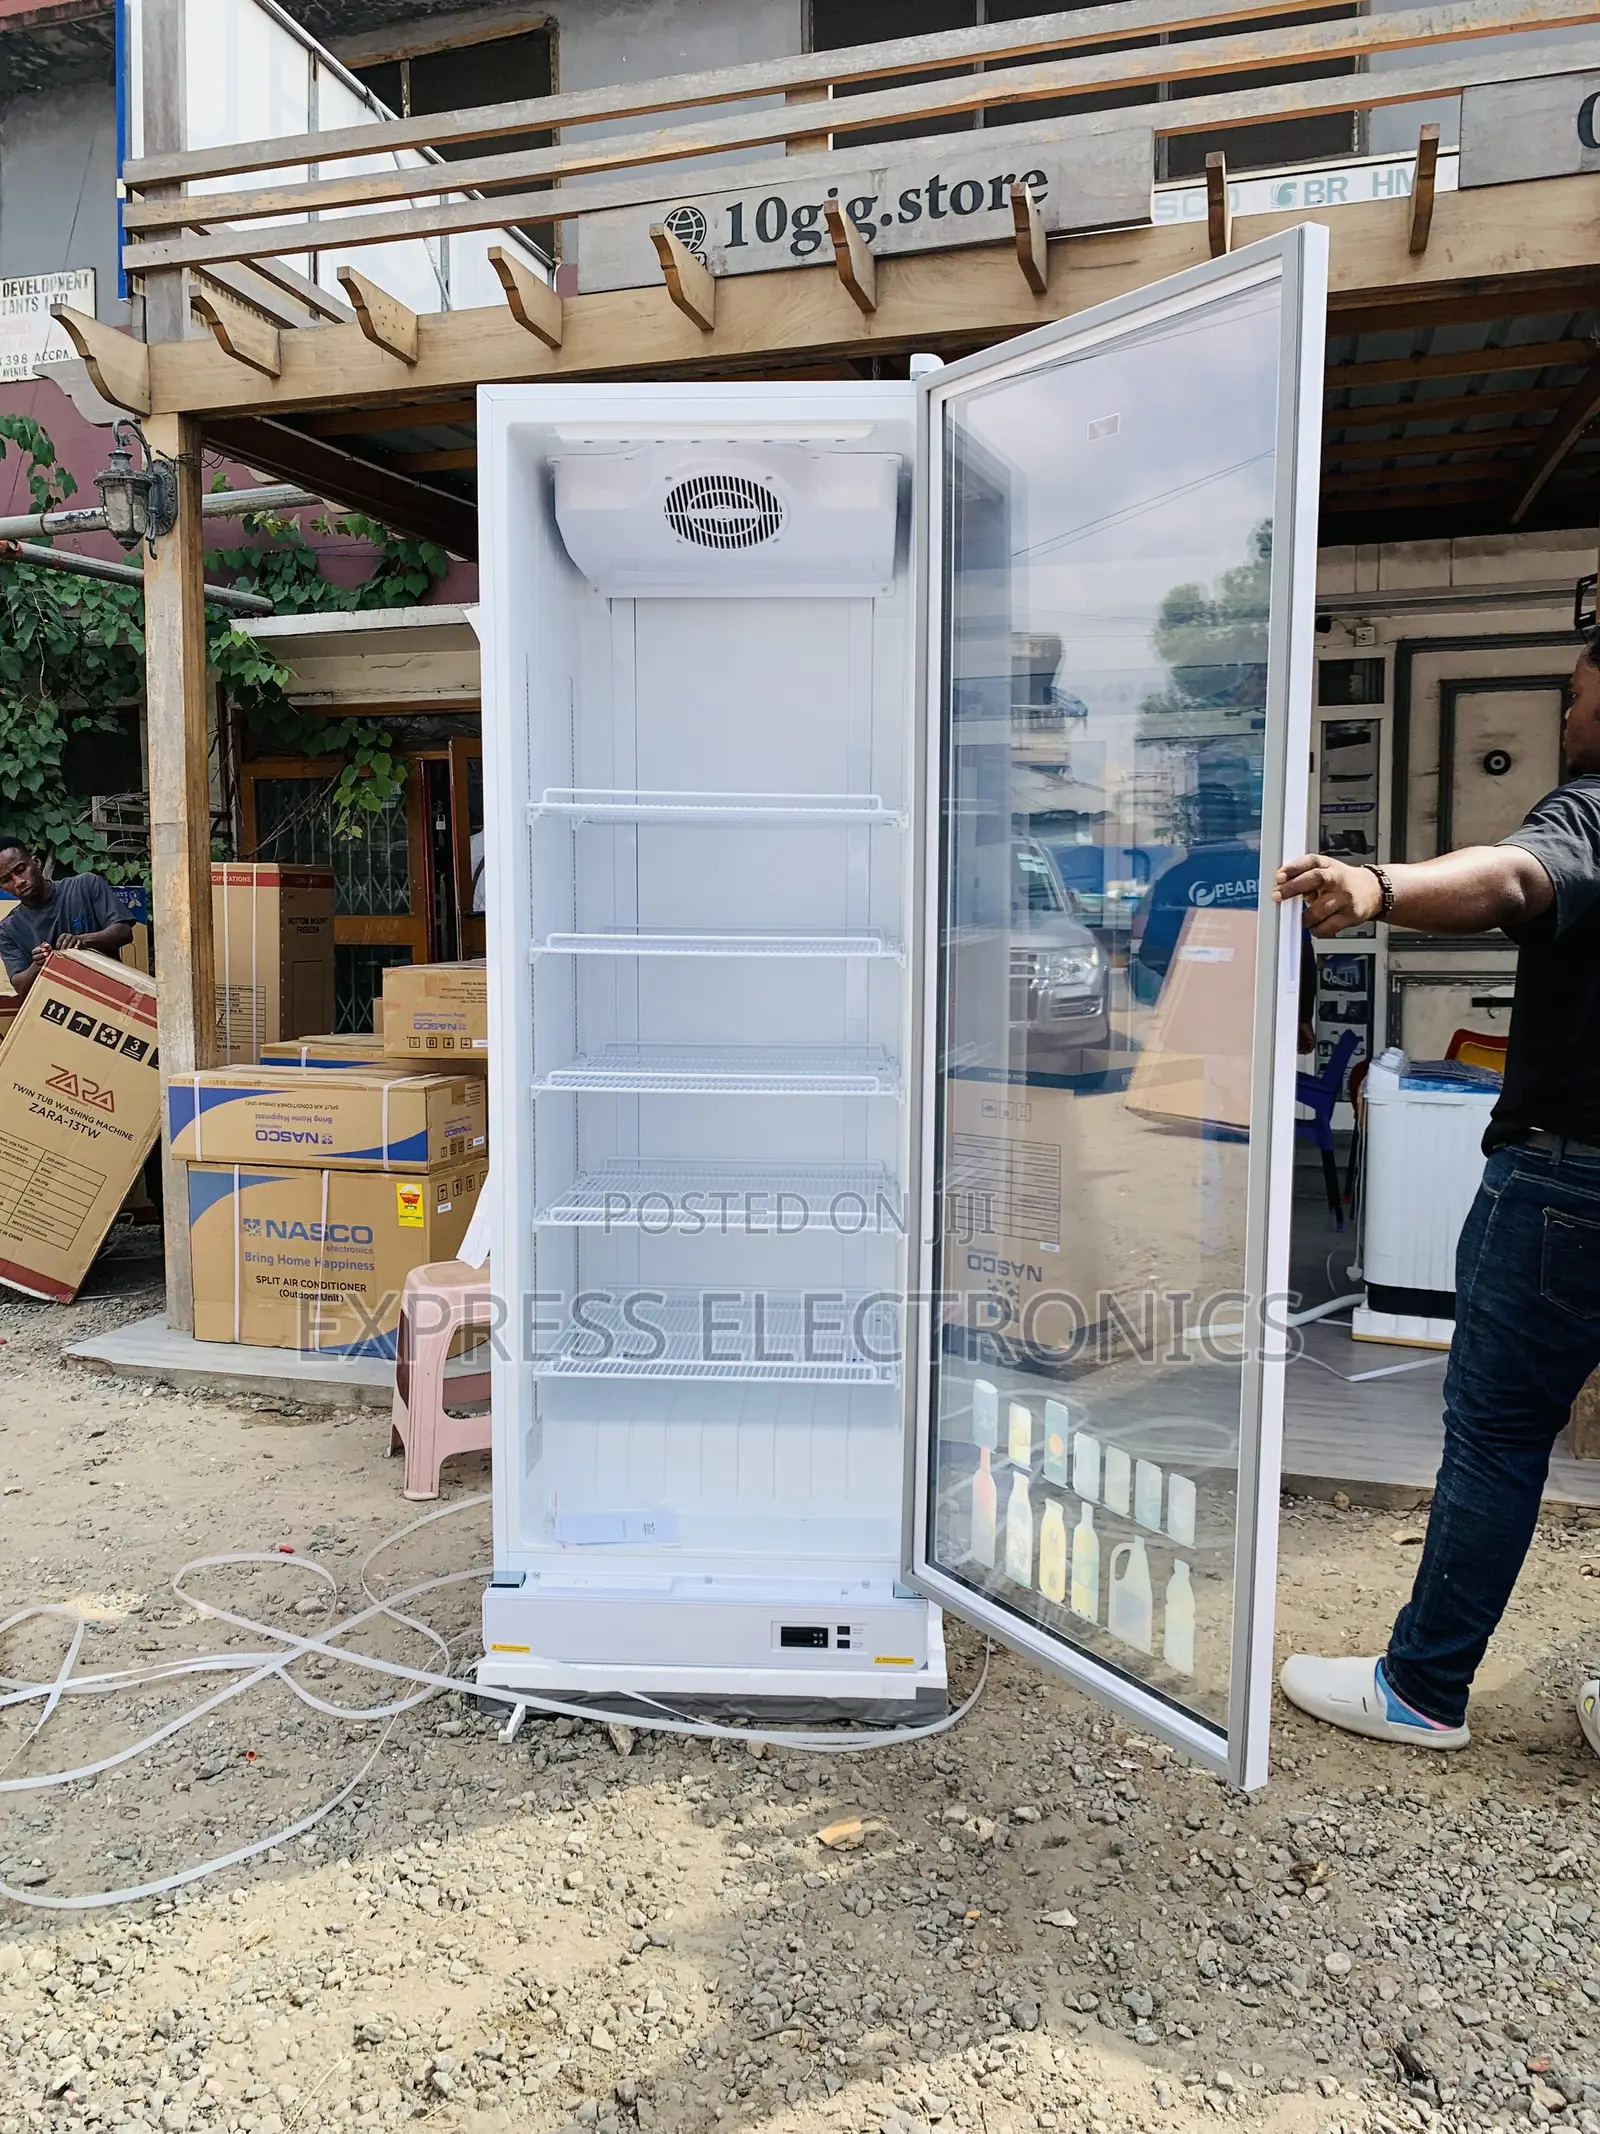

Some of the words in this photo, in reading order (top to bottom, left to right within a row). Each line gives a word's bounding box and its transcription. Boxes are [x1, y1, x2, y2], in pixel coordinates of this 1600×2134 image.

[1304, 176, 1348, 207] BR
[3, 273, 90, 298] DEVELOPMENT
[5, 353, 28, 366] 398
[34, 349, 73, 362] ACCRA.
[3, 365, 28, 377] AVENUE
[211, 875, 252, 883] CIFCATIONS
[1215, 879, 1259, 898] PEAR
[413, 1022, 457, 1031] NASCO
[13, 1082, 36, 1098] TWIN
[37, 1093, 54, 1106] TUB
[55, 1101, 95, 1124] WASHING
[95, 1119, 134, 1141] MACHINE
[255, 1113, 290, 1122] Happiness
[291, 1114, 312, 1123] Home
[314, 1115, 333, 1124] Bring
[29, 1102, 101, 1139] ZARA-13TW
[255, 1130, 319, 1144] NASCO
[265, 1220, 374, 1244] NASCO
[325, 1245, 374, 1255] electronics
[244, 1252, 274, 1266] Bring
[277, 1254, 311, 1267] Home
[314, 1259, 375, 1272] Happiness
[967, 1254, 1042, 1282] NASCO
[256, 1275, 281, 1285] SPLIT
[283, 1278, 298, 1287] AIR
[300, 1279, 367, 1292] CONDITIONER
[279, 1290, 319, 1301] (Outdoor
[320, 1291, 344, 1303] Unit)
